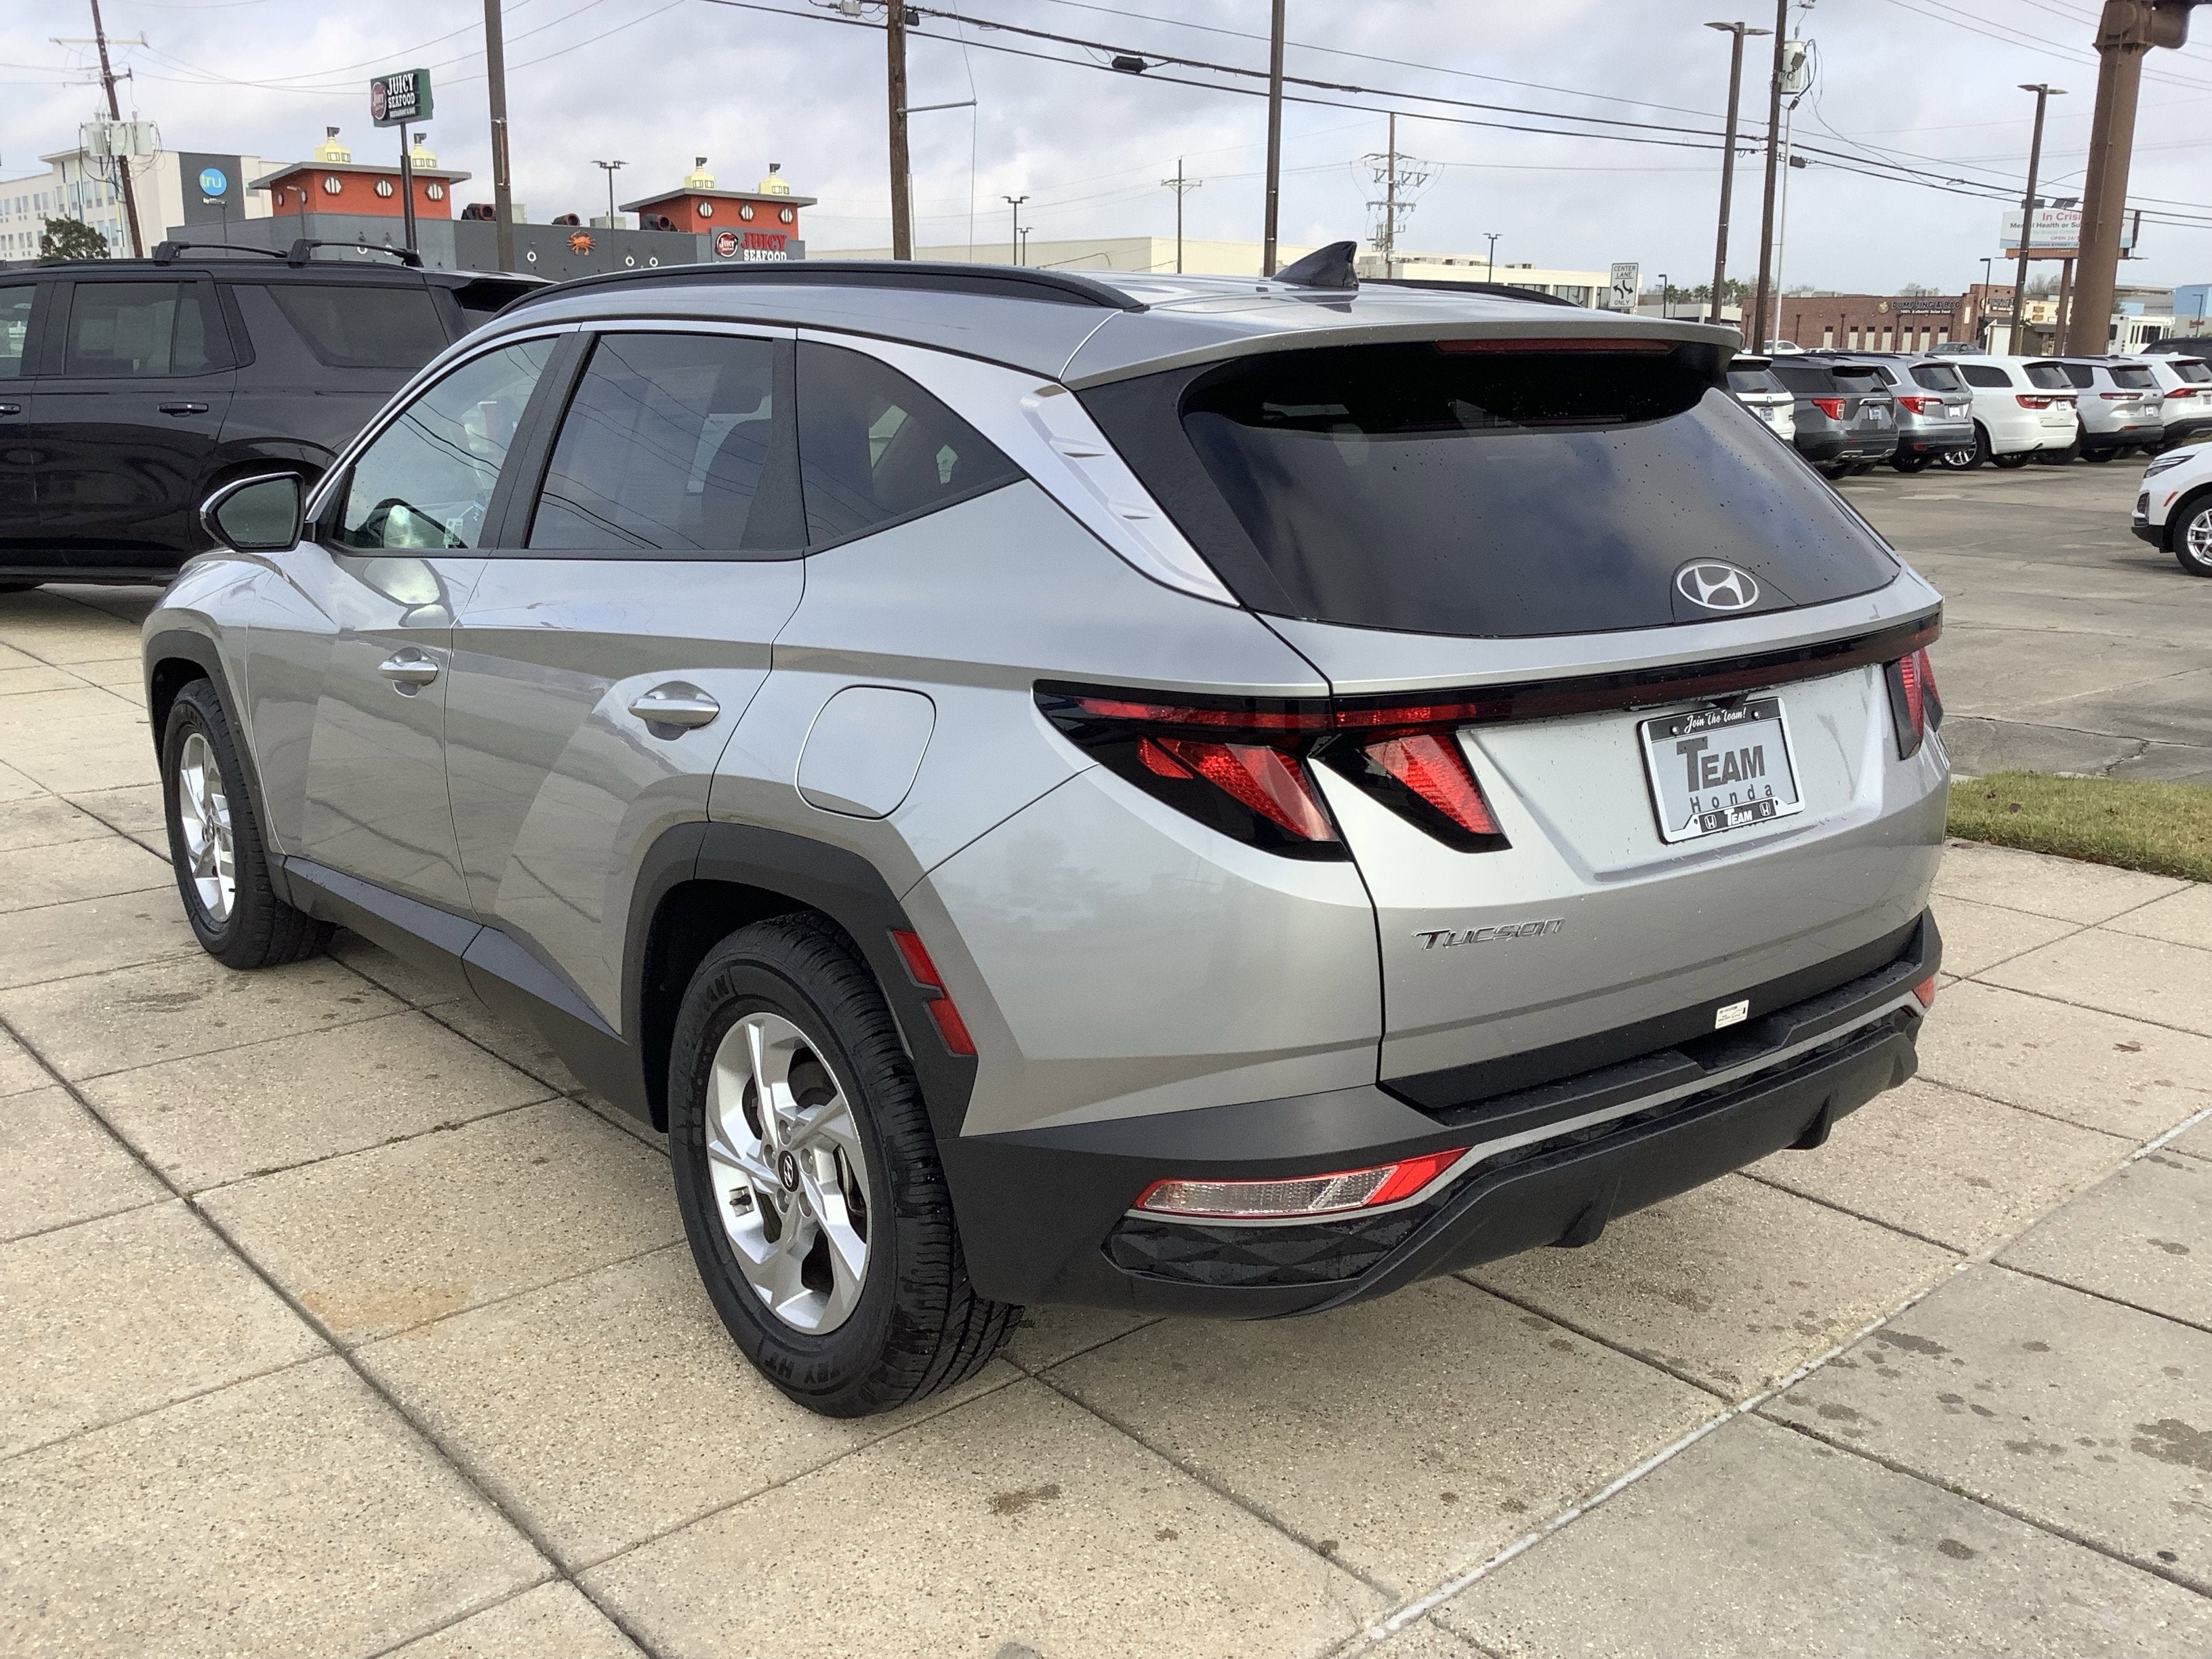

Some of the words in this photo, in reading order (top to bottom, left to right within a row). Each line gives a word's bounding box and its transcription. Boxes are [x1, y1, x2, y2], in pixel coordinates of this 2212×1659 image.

[387, 73, 413, 96] JUICY
[388, 92, 415, 108] SEAFOOD
[201, 174, 222, 188] tru
[2042, 213, 2053, 221] In
[2056, 212, 2083, 221] Crisi
[741, 232, 787, 251] JUICY
[743, 249, 787, 262] SEAFOOD
[1892, 301, 1934, 309] DUMPLING
[1944, 301, 1961, 309] BAO
[1684, 714, 1706, 734] Join
[1705, 712, 1722, 726] The
[1721, 708, 1747, 722] Team!
[1676, 736, 1765, 792] TEAM
[1689, 784, 1774, 813] Honda
[1724, 808, 1753, 826] TEAM
